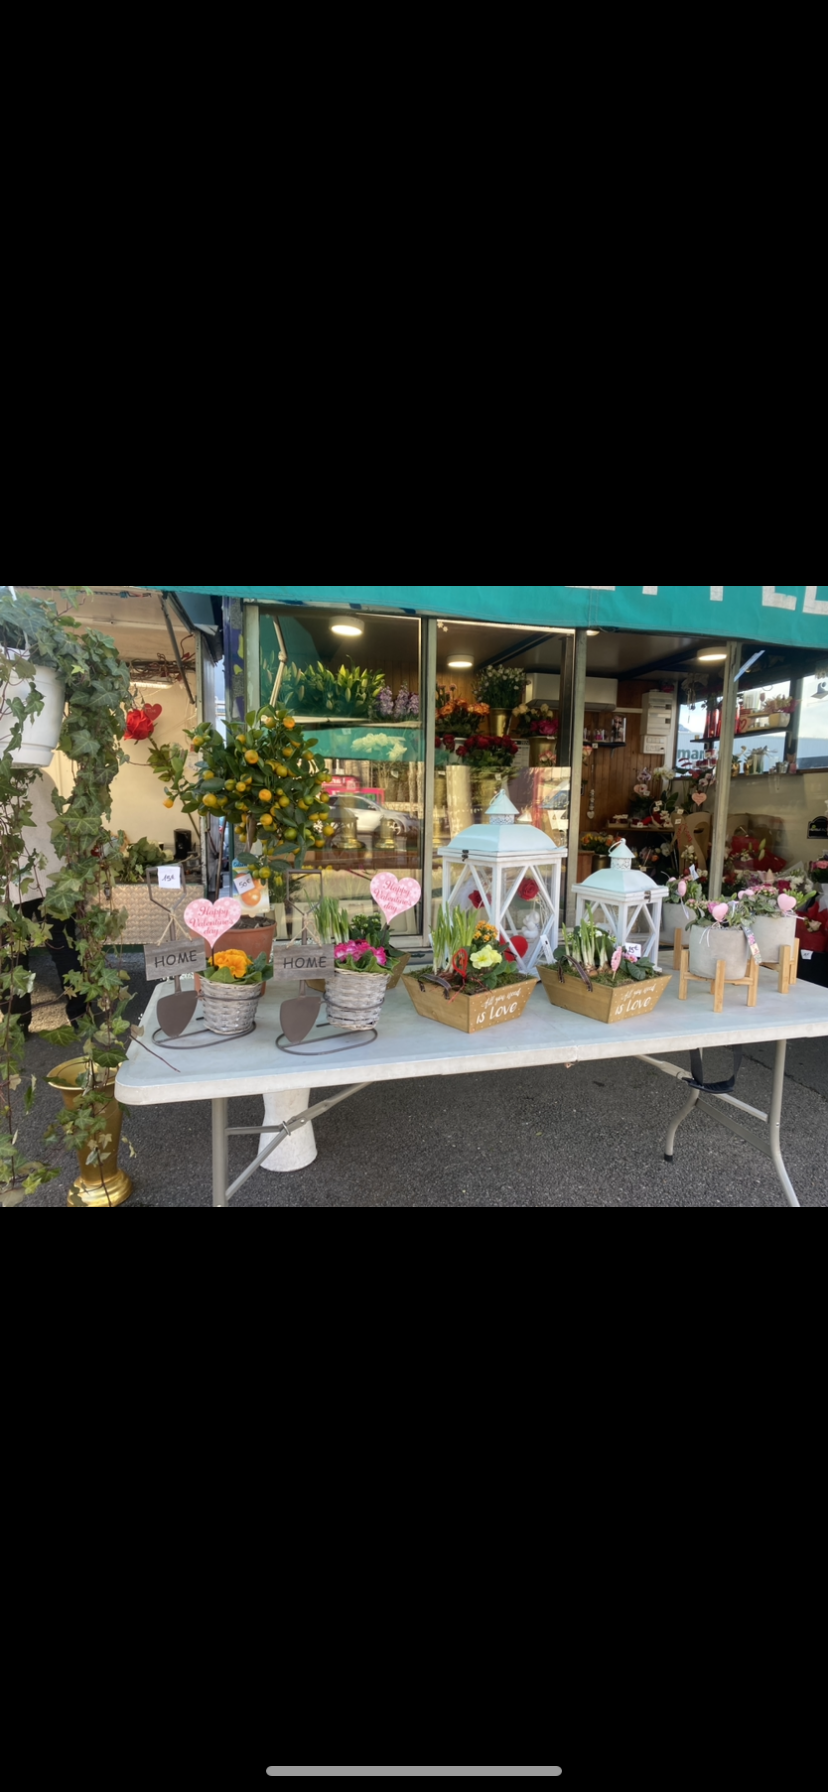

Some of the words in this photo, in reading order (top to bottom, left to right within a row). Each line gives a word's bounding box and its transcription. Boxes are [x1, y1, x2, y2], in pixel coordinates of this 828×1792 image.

[238, 878, 251, 889] 50€
[382, 880, 411, 895] Happy
[374, 889, 412, 906] Valentine's
[198, 906, 229, 917] Happy
[383, 902, 398, 913] day
[189, 918, 234, 928] Valentine's
[203, 927, 219, 937] day
[154, 949, 197, 968] HOME
[283, 956, 327, 969] HOME
